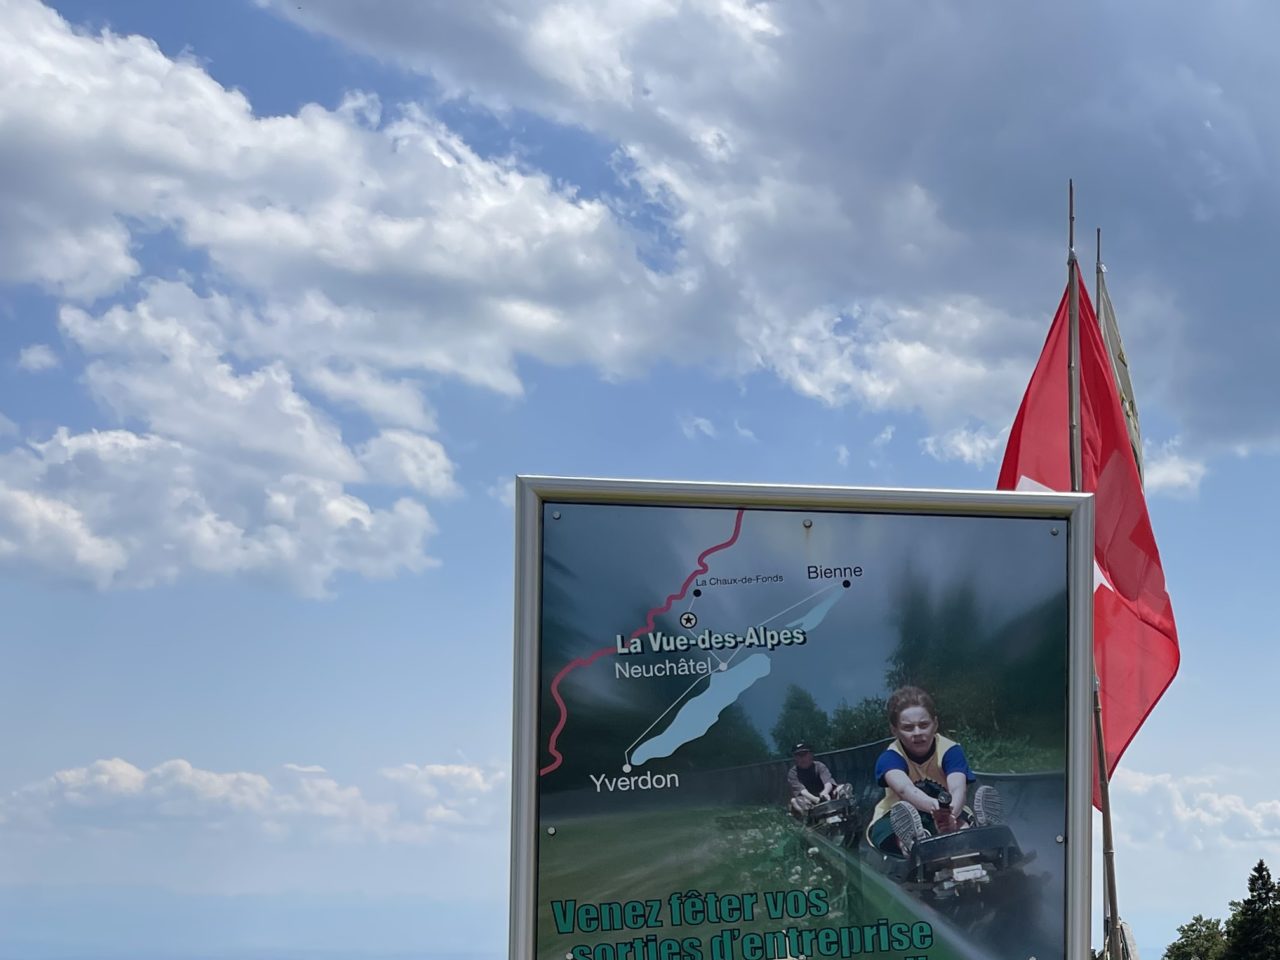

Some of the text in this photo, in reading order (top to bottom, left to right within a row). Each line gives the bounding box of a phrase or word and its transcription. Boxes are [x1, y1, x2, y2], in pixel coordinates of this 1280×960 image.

[709, 574, 784, 586] Chaux-de-Fonds
[807, 565, 863, 580] Bienne
[616, 626, 806, 655] La Vue-des-Alpes
[614, 657, 712, 679] Neuchâtel
[590, 770, 680, 793] Yverdon
[551, 887, 830, 934] Venez fêter vos
